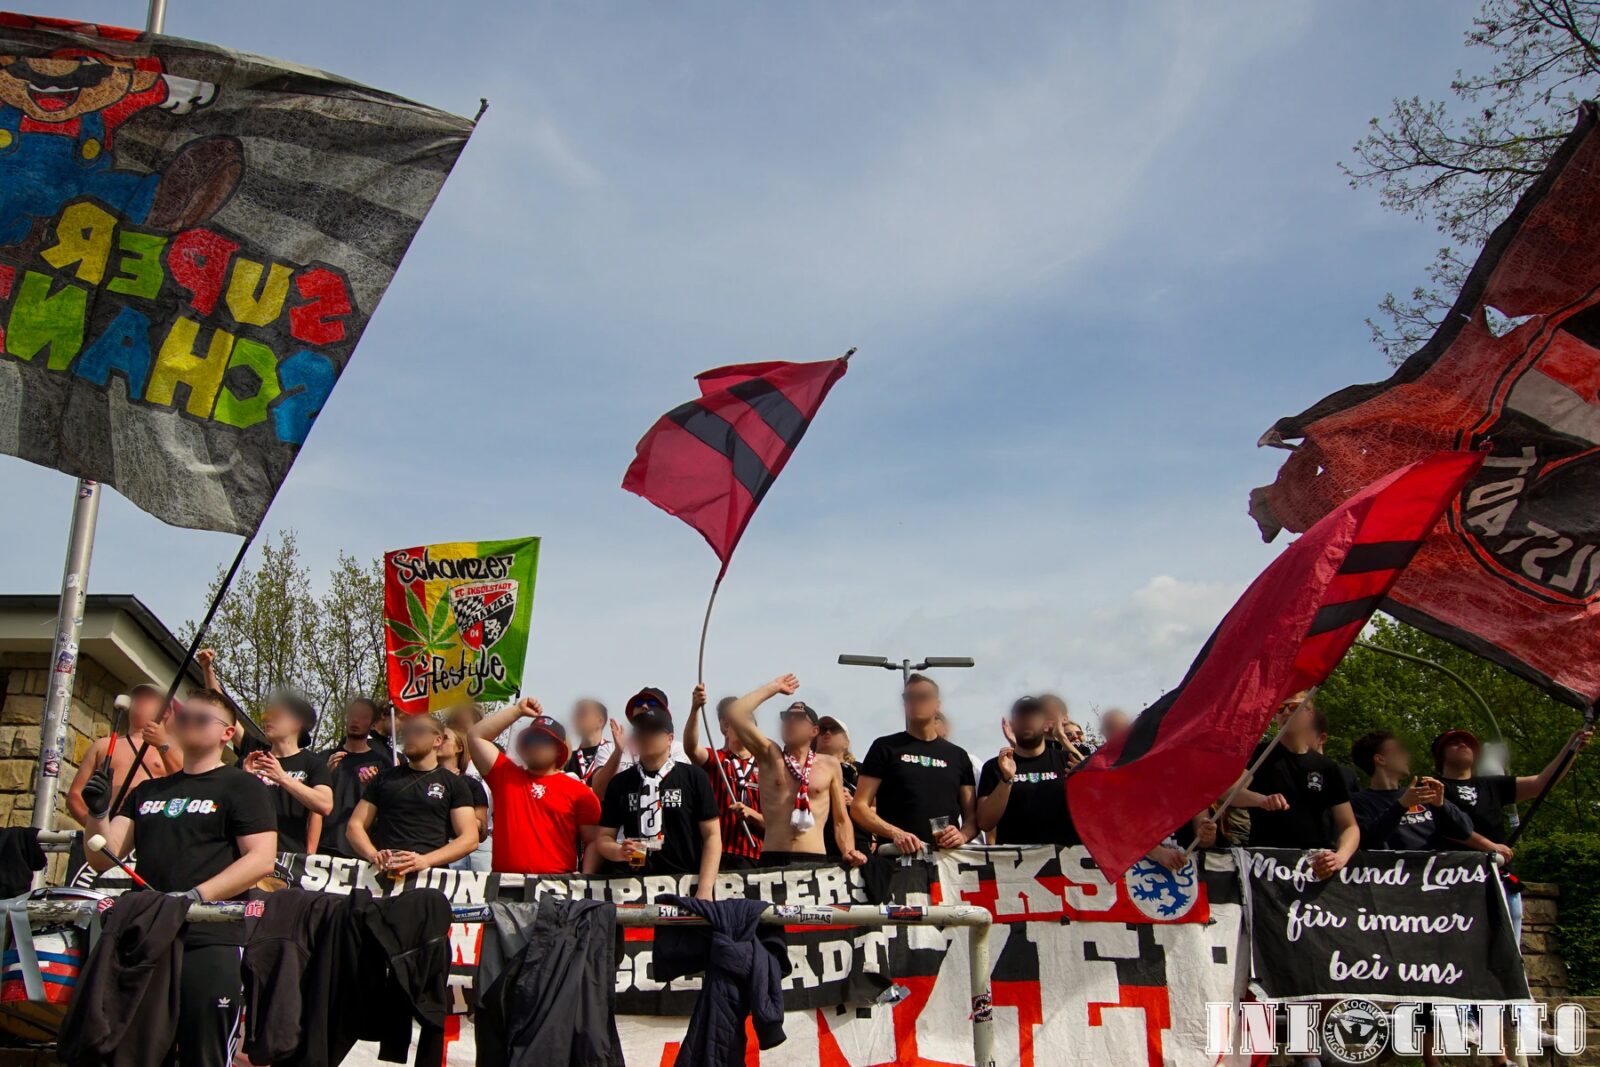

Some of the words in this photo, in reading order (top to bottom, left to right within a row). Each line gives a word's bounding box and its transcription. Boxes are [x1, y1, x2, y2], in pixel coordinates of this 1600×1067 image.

[392, 549, 515, 584] Schanzer
[461, 593, 514, 632] SCHANZER
[401, 645, 506, 702] Lifestyle
[1340, 858, 1411, 886] und
[1421, 856, 1490, 892] Lars
[799, 913, 831, 924] ULTRAS
[1286, 899, 1347, 942] für
[1357, 907, 1474, 934] immer
[1329, 950, 1390, 981] bei
[1398, 961, 1463, 985] uns
